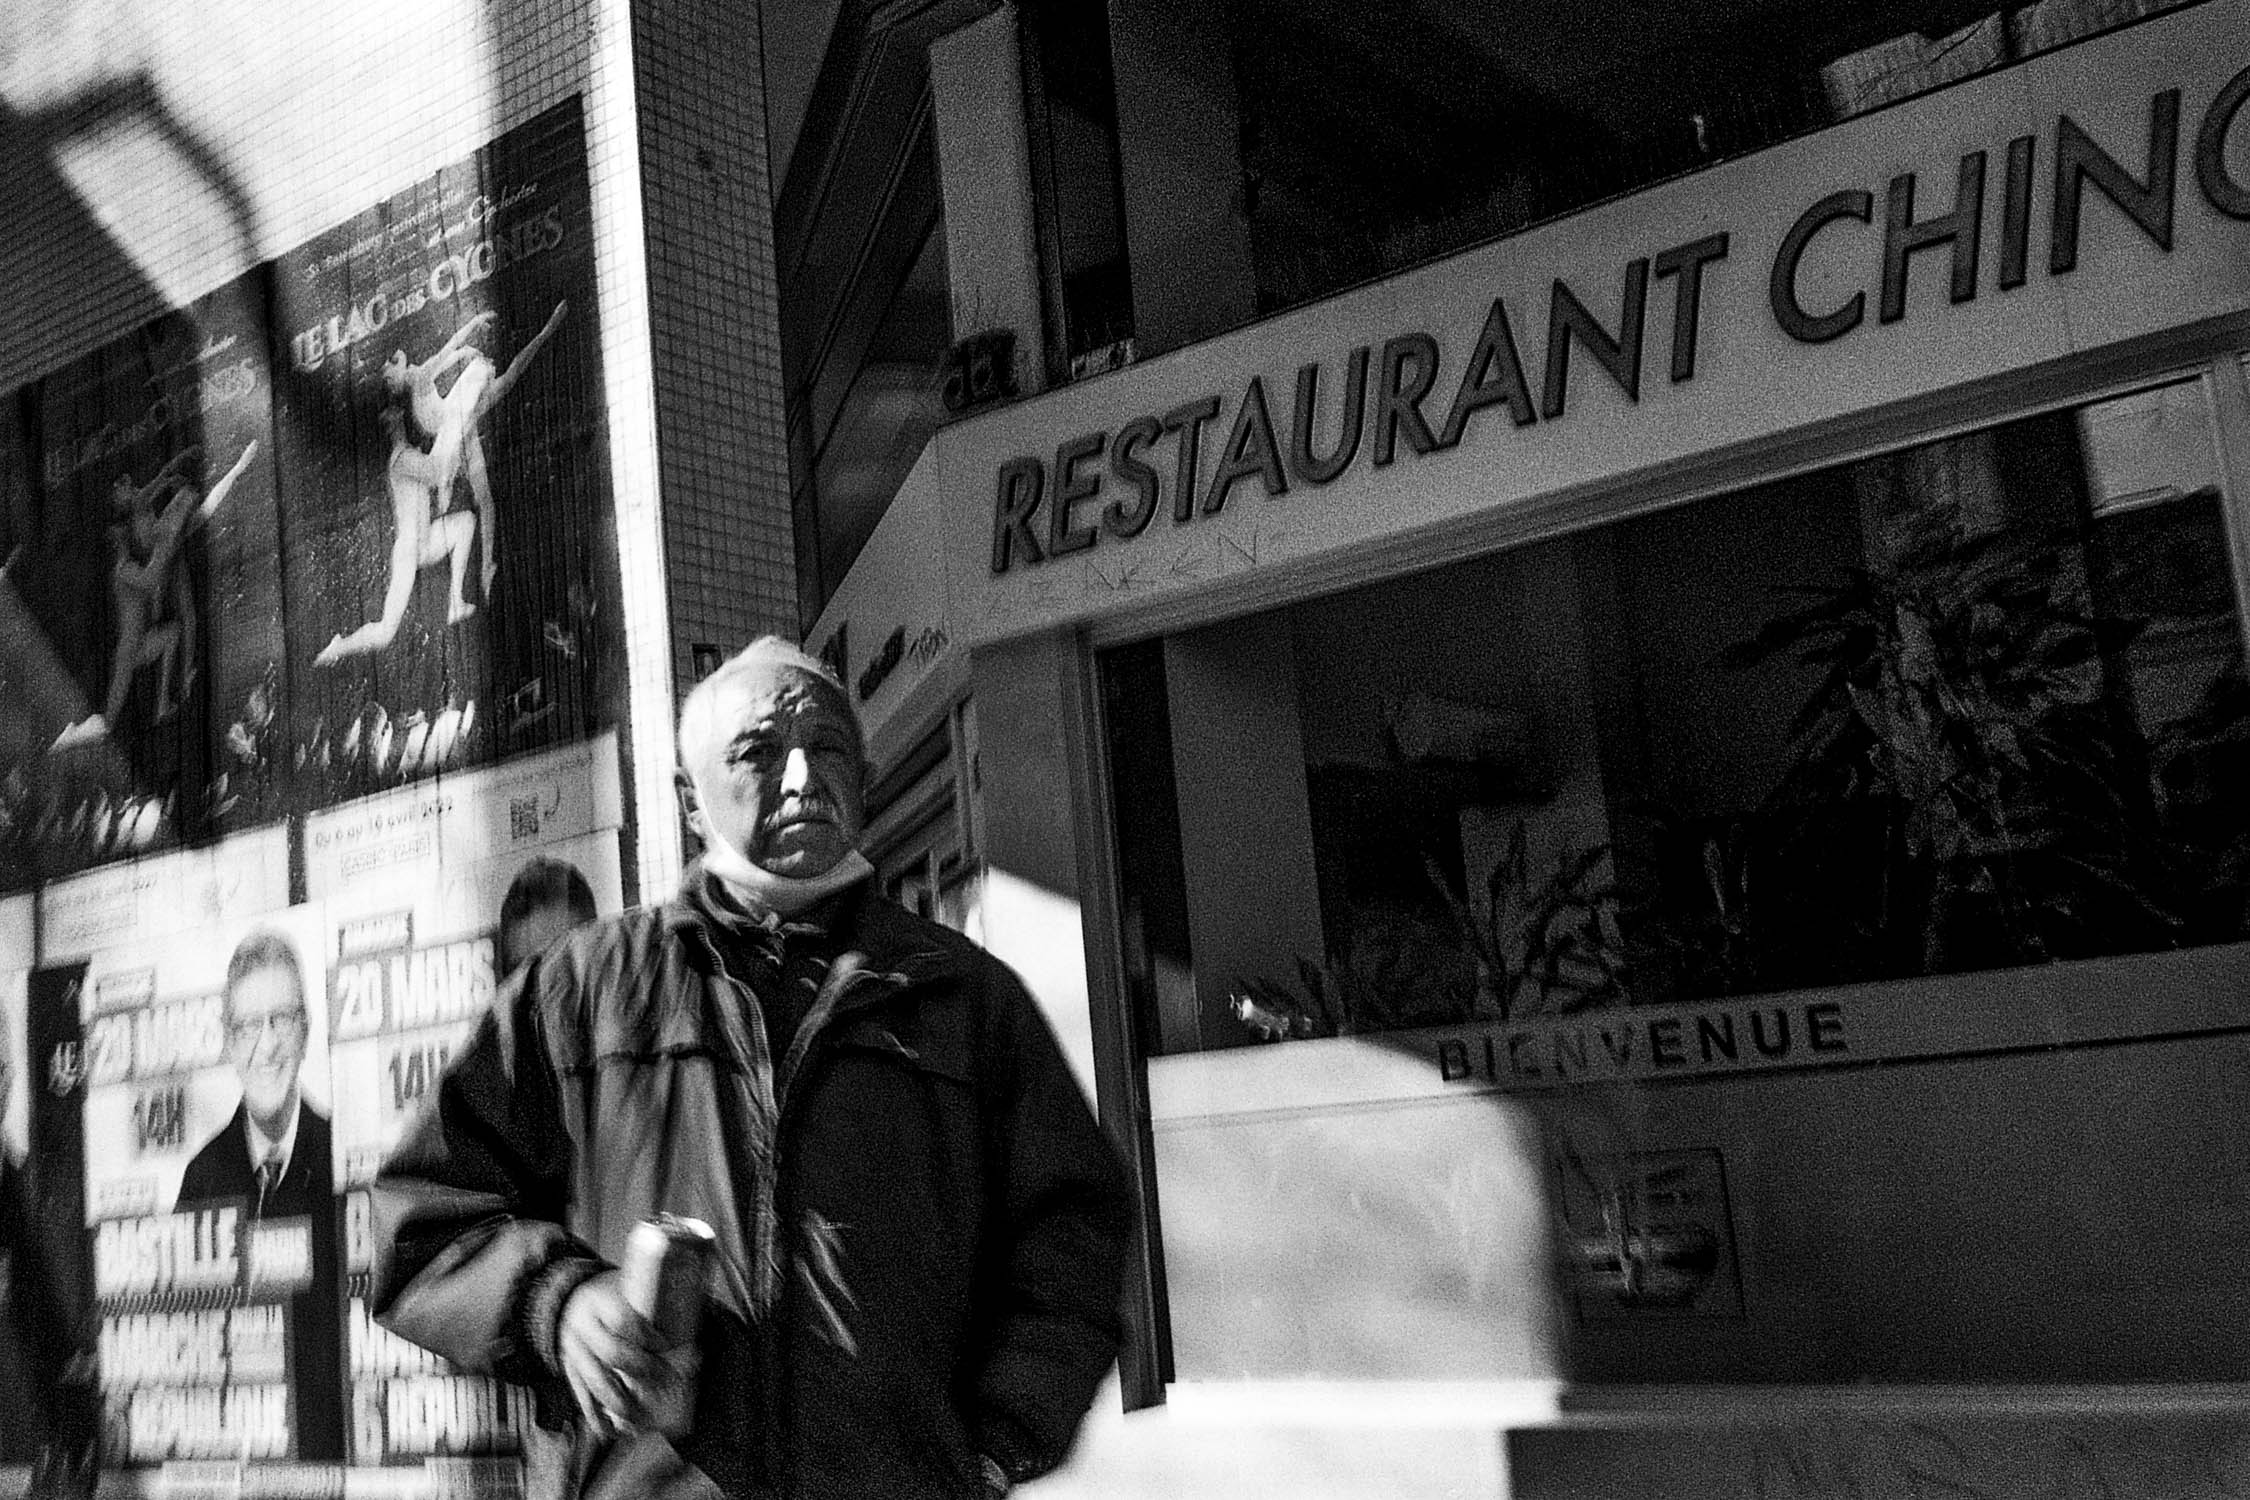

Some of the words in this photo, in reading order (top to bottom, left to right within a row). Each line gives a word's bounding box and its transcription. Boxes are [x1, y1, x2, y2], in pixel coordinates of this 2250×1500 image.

[327, 291, 389, 354] LAC
[429, 204, 564, 303] CYGNES
[991, 230, 1729, 575] RESTAURANT
[336, 958, 385, 1038] 20
[389, 936, 497, 1031] MARS
[87, 1012, 132, 1085] 20
[1437, 1002, 1850, 1084] BIENVENUE
[94, 1205, 239, 1299] BASTILLE
